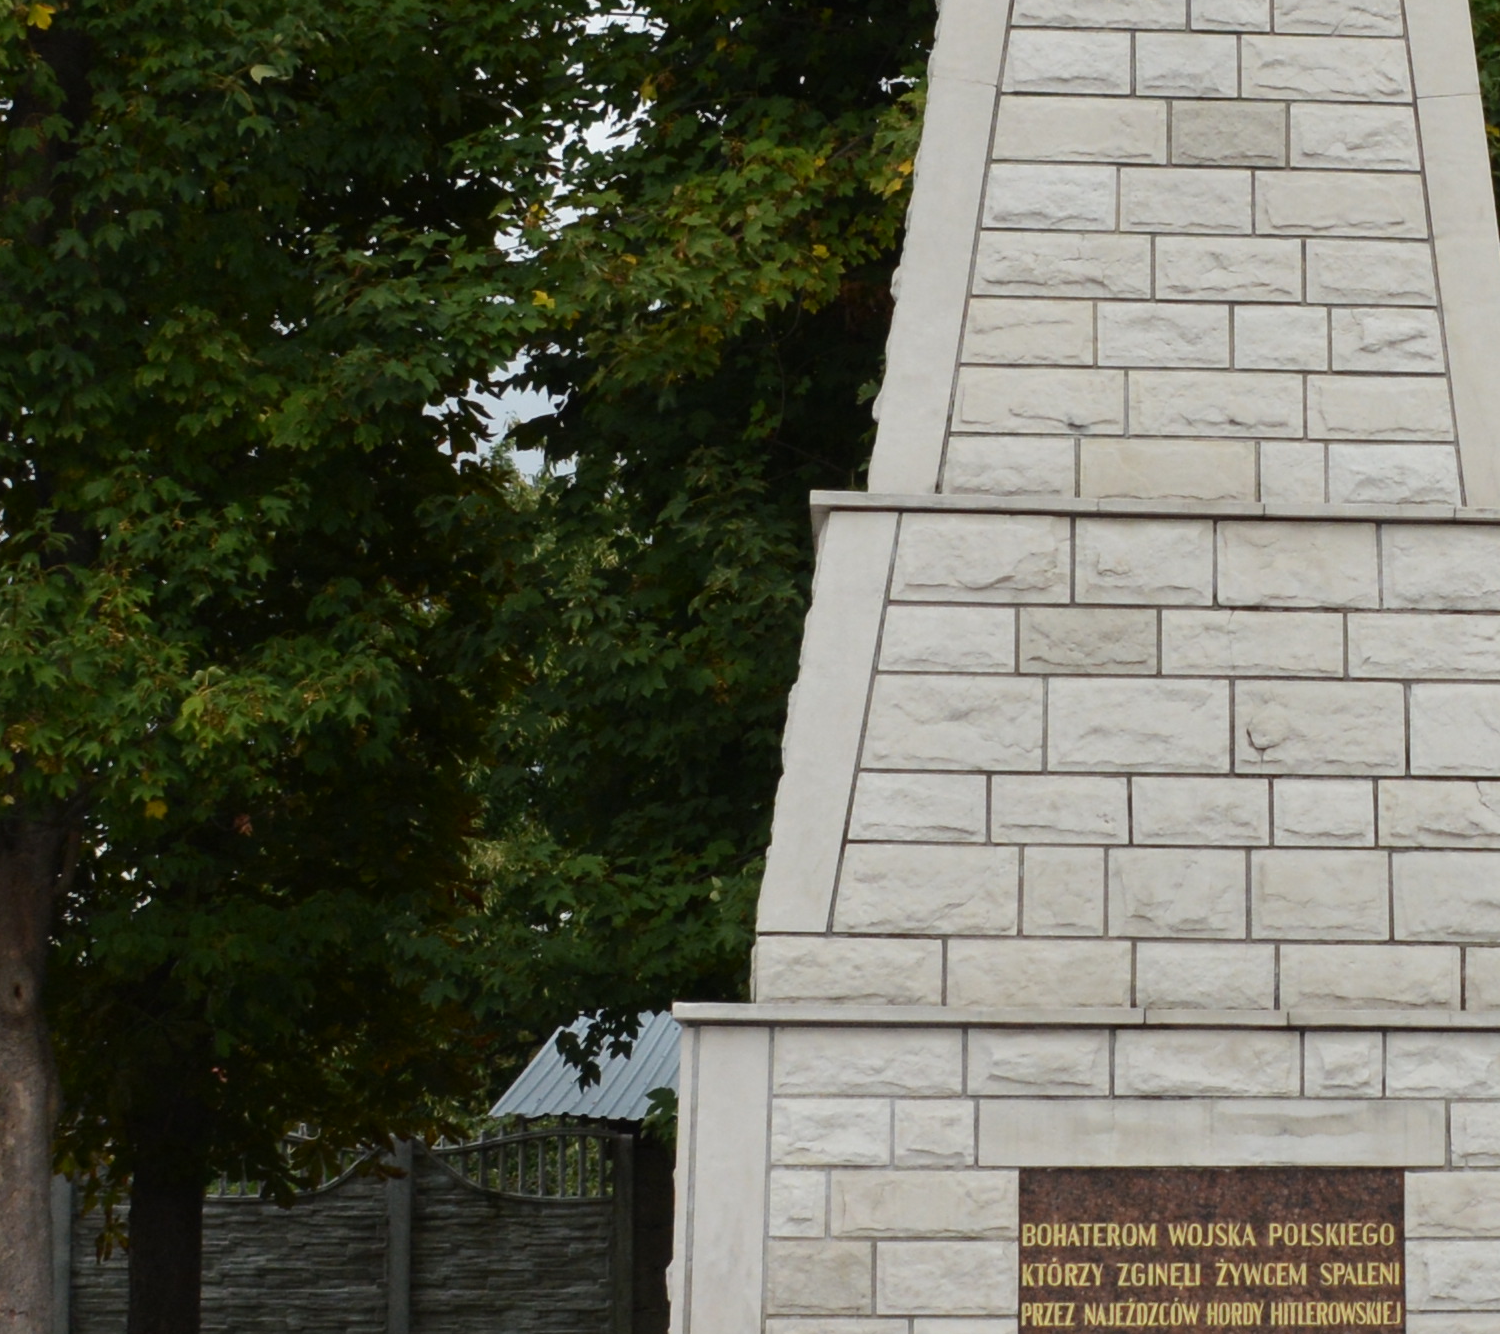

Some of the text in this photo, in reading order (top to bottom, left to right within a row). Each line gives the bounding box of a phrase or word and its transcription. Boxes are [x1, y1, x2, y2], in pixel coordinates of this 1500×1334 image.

[1022, 1223, 1395, 1247] BOHATEROM WOJSKA POLSKIEGO
[1021, 1258, 1400, 1289] KTÓRZY ZGINĘLI ŻYWCEM SPALENI
[1021, 1297, 1402, 1327] PRZEZ NAJEŹDZCÓW HORDY HITLEROWSKIEJ
